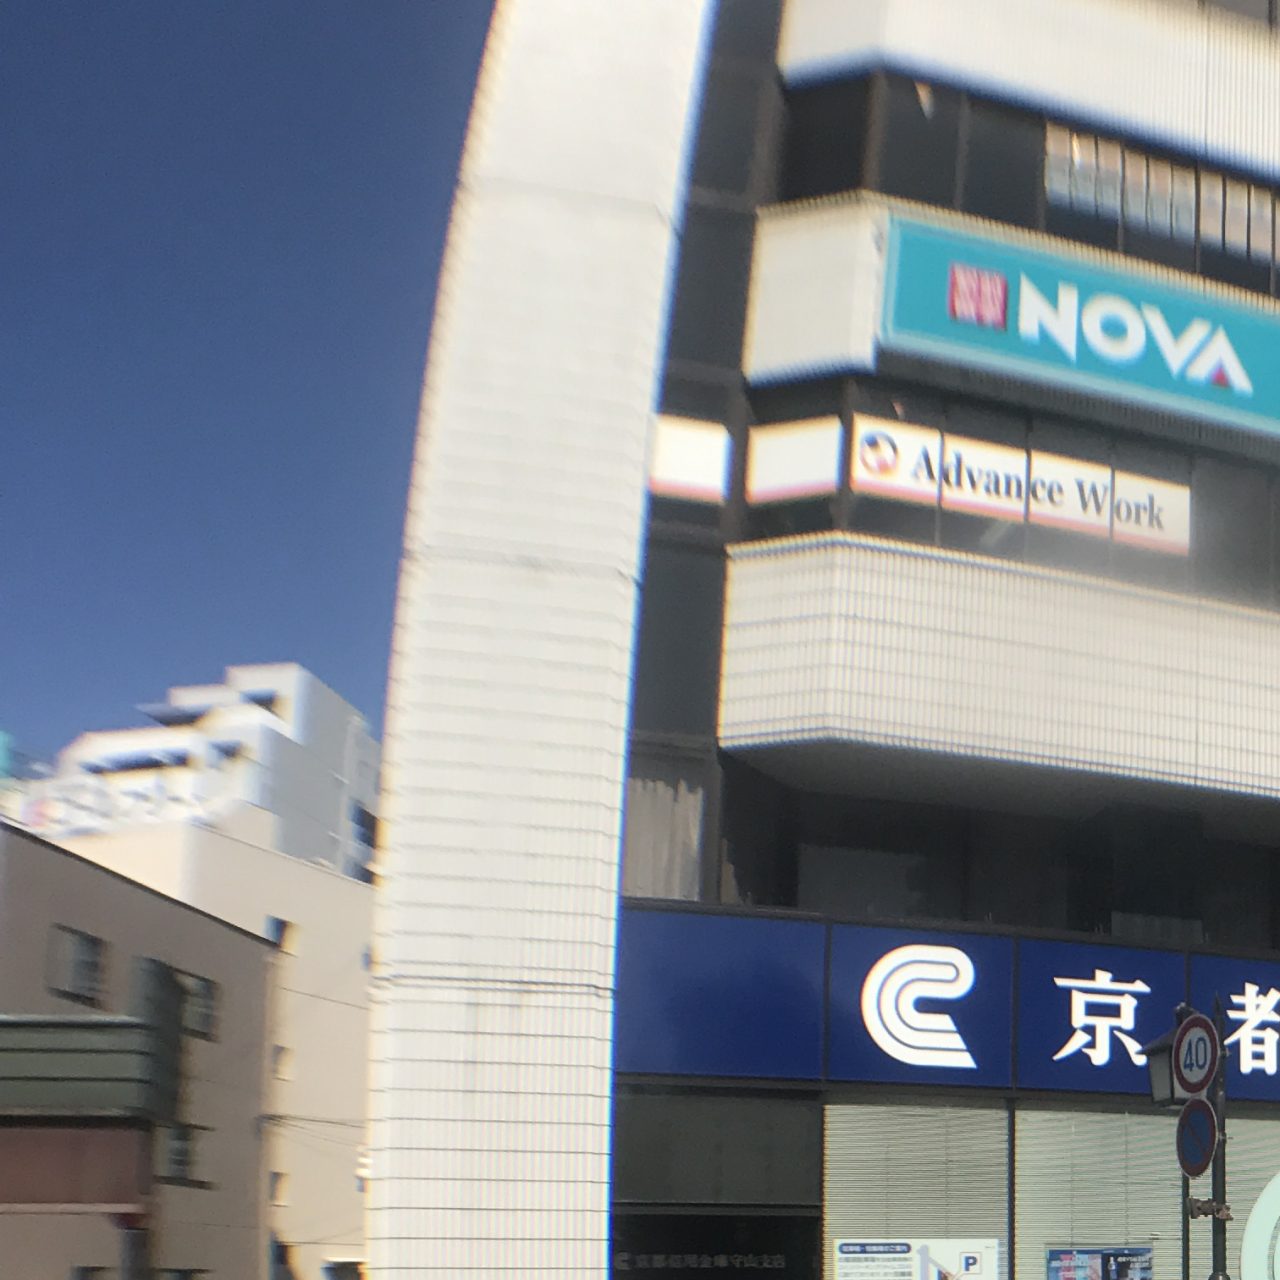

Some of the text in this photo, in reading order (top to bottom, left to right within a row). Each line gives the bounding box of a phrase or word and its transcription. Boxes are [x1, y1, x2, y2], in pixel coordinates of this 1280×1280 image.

[1018, 272, 1254, 398] NOVA
[909, 445, 1166, 530] Advance Work
[1183, 1037, 1208, 1072] 40
